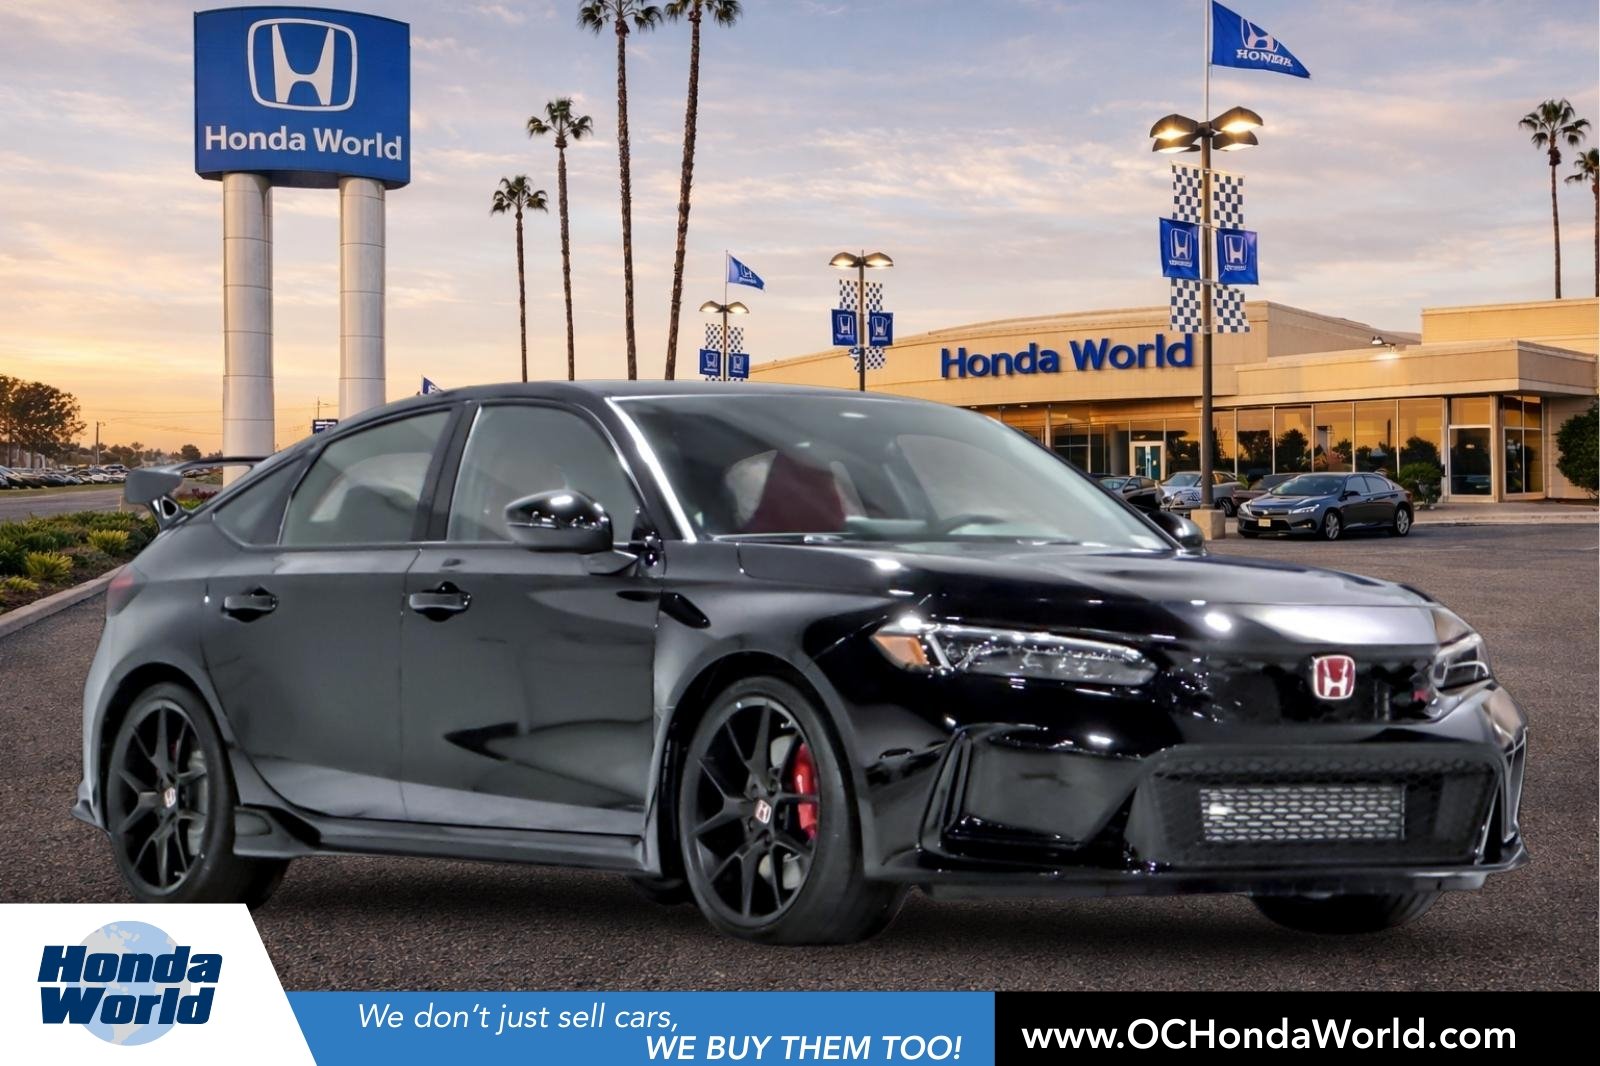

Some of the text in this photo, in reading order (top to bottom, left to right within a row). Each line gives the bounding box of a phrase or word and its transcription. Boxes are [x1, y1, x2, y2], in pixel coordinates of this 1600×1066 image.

[205, 125, 402, 161] Honda World
[941, 333, 1193, 378] Honda World
